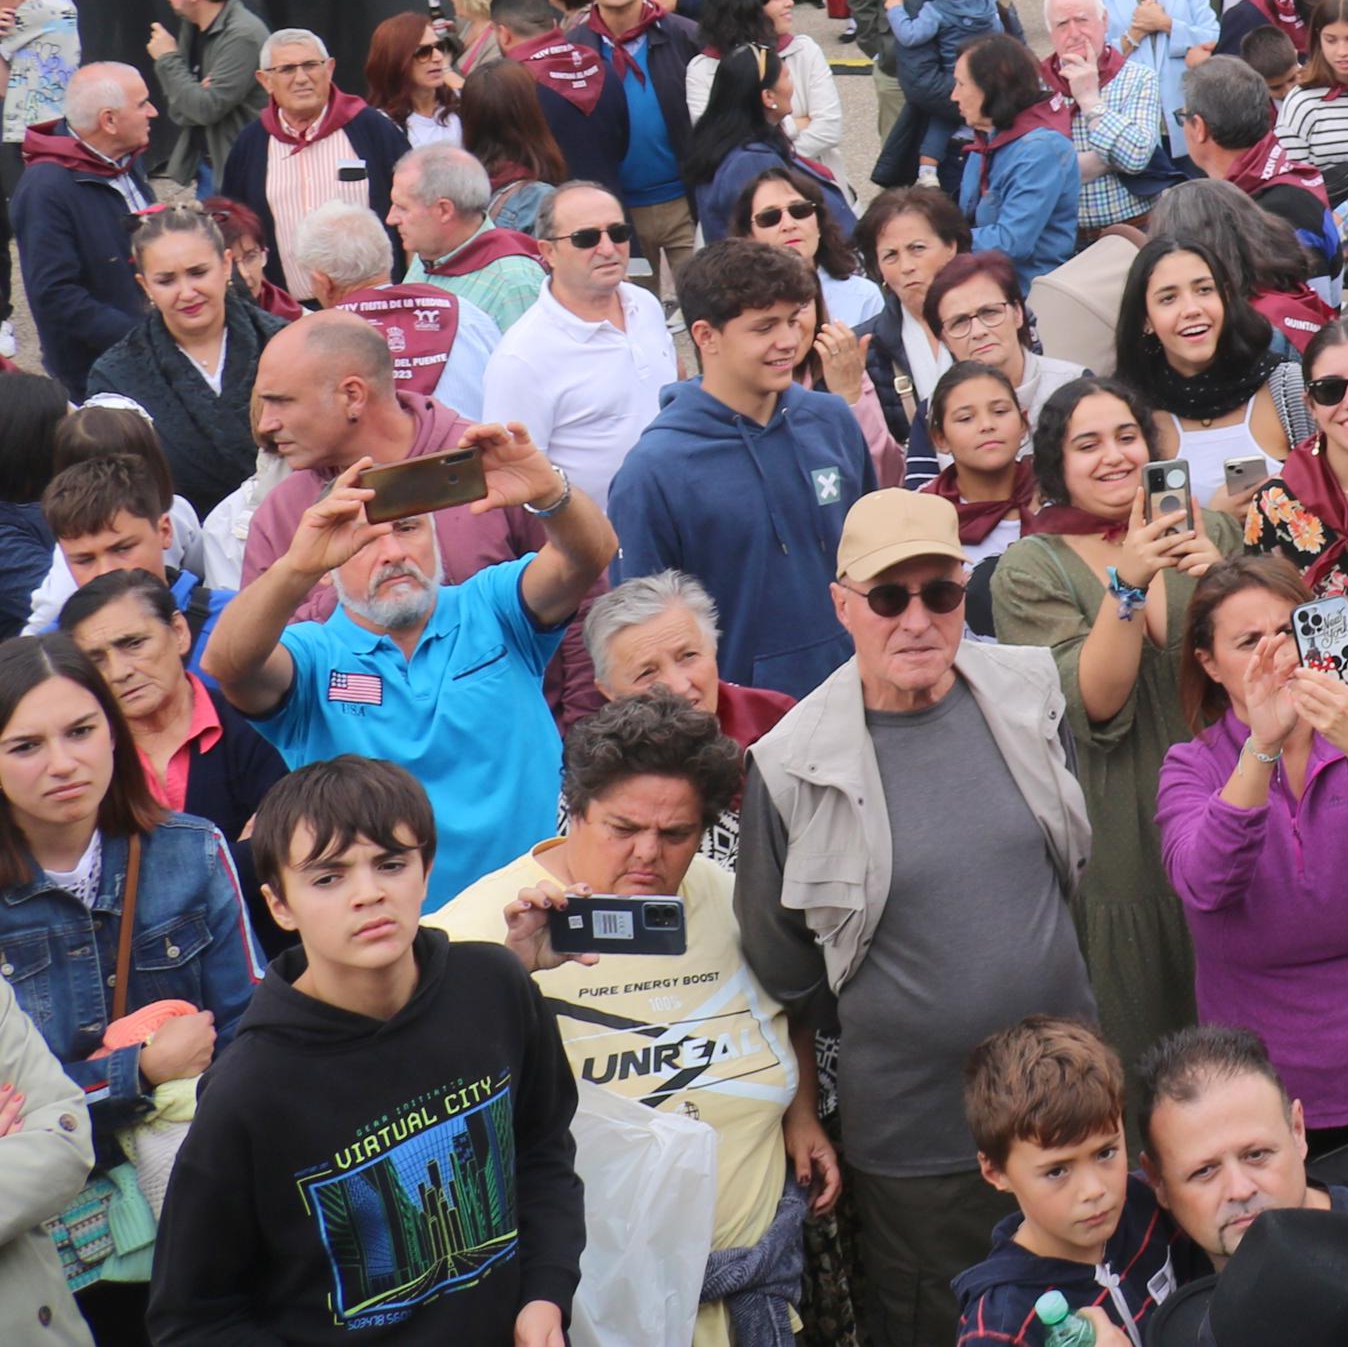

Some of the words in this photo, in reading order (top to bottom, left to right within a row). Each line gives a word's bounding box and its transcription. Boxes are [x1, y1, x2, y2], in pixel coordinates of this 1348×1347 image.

[394, 357, 412, 368] DEL
[412, 353, 448, 367] PUENTE
[392, 369, 413, 380] 023
[341, 703, 367, 717] USA
[578, 984, 619, 998] PURE
[623, 977, 679, 994] ENERGY
[682, 971, 721, 986] BOOST
[581, 1026, 763, 1085] UNREAL
[335, 1107, 438, 1169] VIRTUAL
[444, 1075, 492, 1115] CITY
